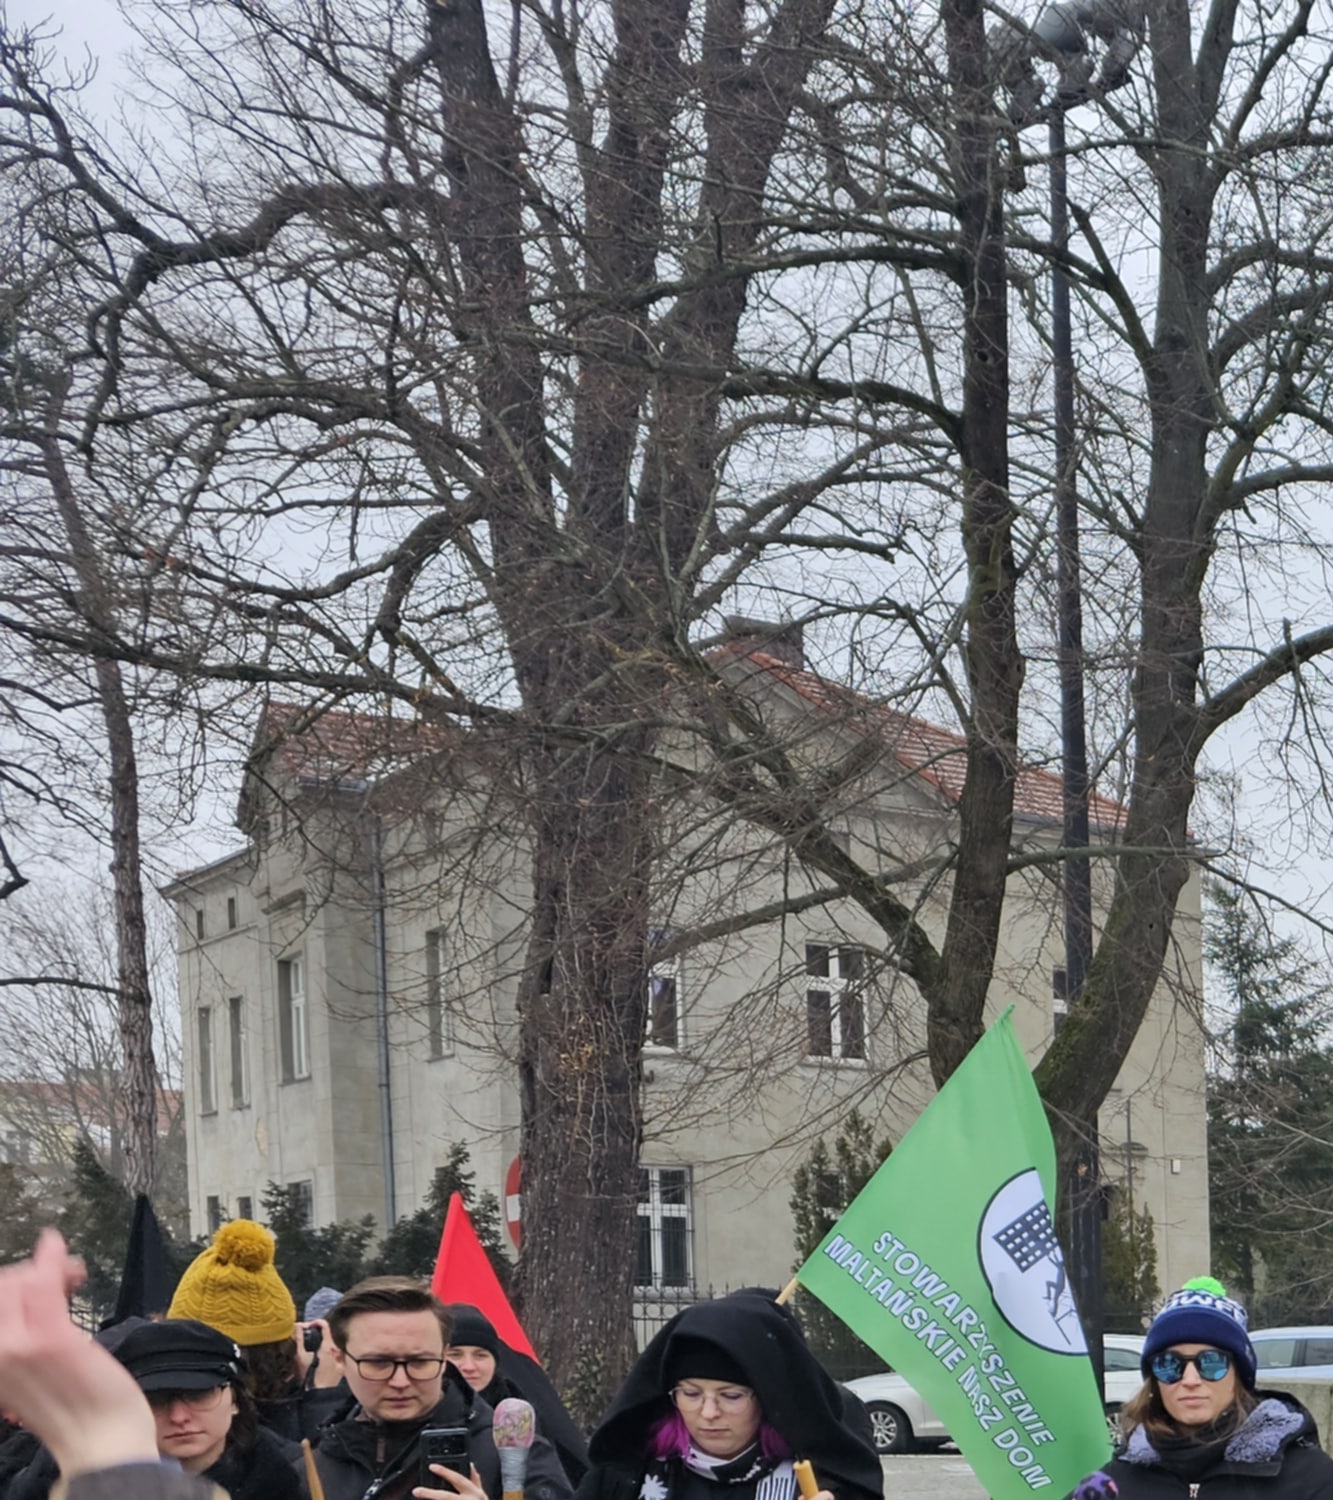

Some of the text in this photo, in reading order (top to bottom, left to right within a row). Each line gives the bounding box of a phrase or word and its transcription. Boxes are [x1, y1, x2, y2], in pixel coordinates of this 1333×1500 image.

[823, 1233, 1053, 1491] MALTAŃSKIE NASZ DOM
[873, 1231, 1055, 1446] STOWARZYSZENIE
